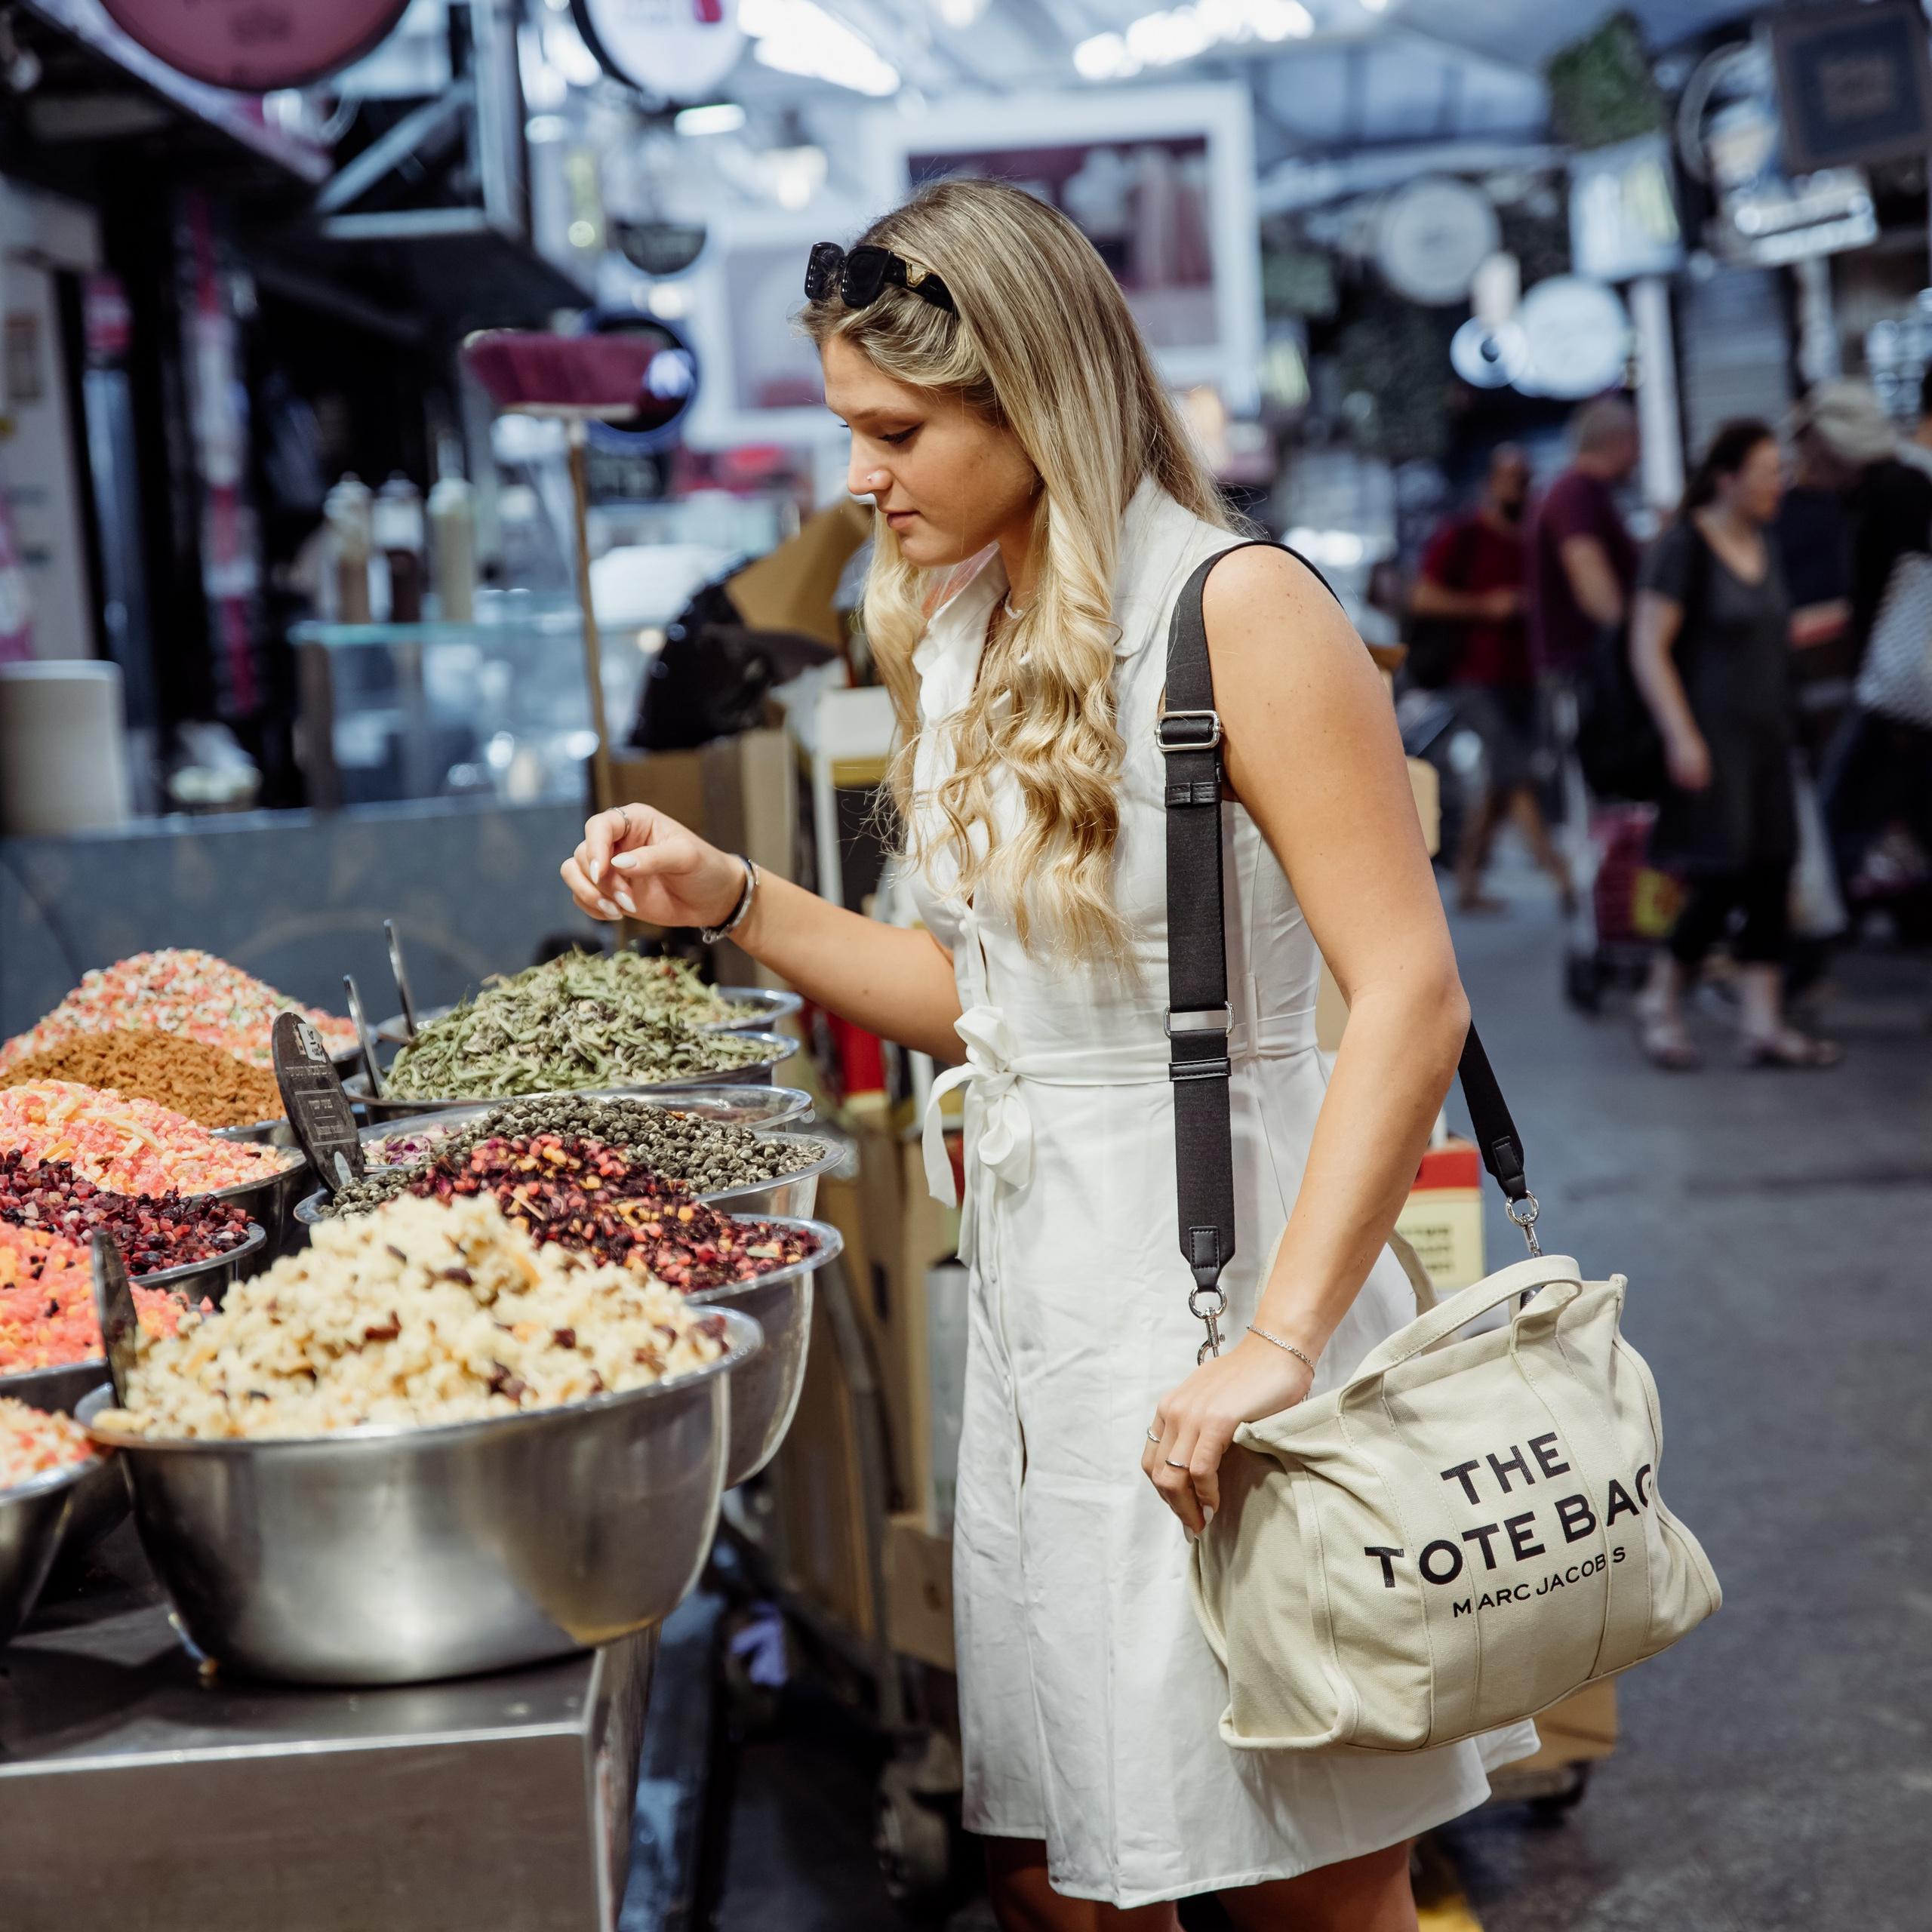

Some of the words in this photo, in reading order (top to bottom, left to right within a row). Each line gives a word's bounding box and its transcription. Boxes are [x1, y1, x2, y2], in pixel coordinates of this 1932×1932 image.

[1440, 1432, 1571, 1506] THE
[1364, 1511, 1546, 1589] TOTE
[1452, 1583, 1531, 1618] MARC
[1536, 1546, 1626, 1595] JACOBS
